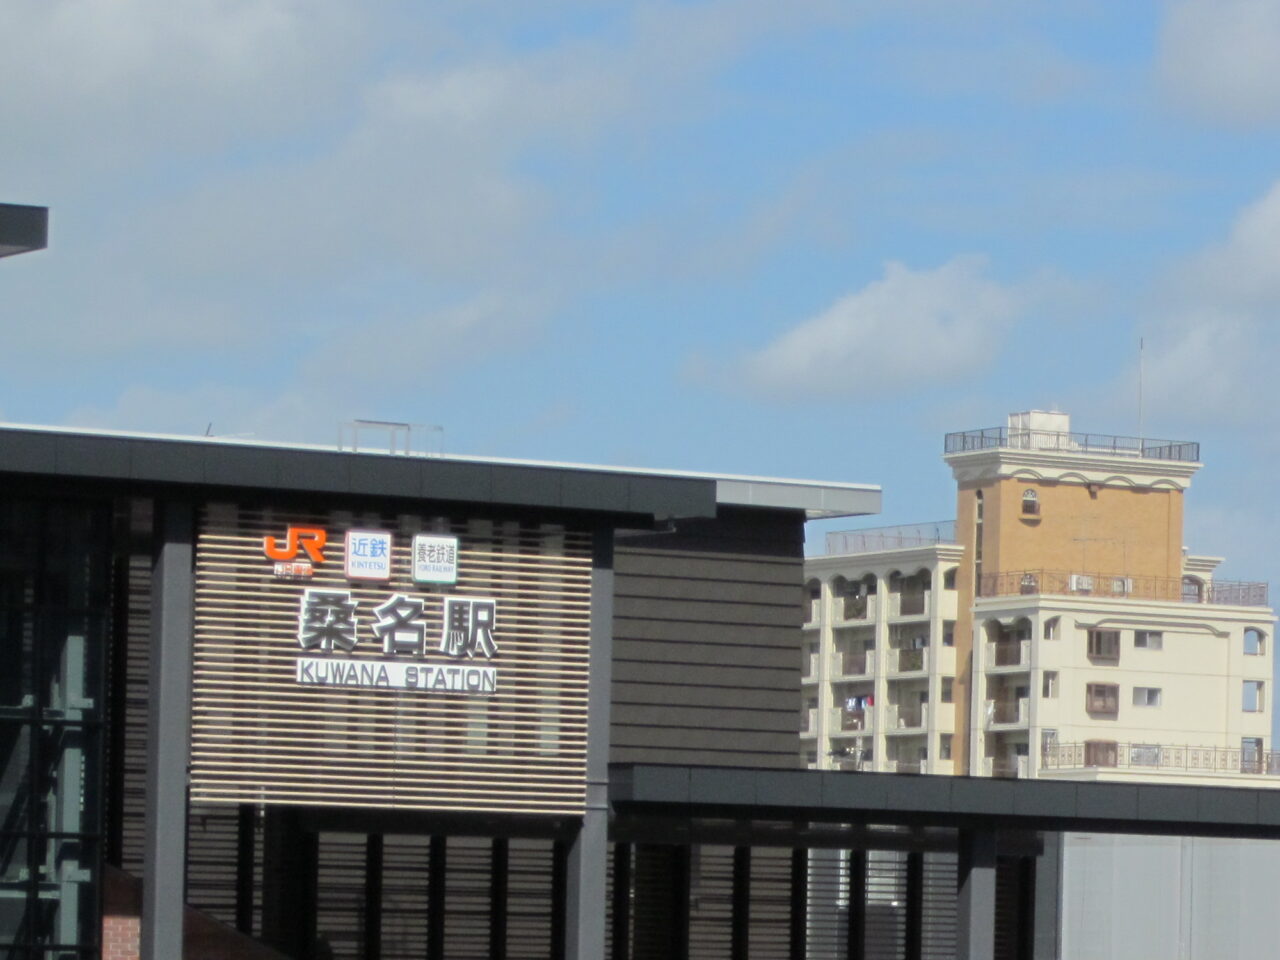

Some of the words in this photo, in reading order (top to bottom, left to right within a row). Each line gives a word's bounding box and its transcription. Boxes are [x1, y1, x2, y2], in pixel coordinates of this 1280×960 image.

[263, 526, 327, 563] JR
[351, 537, 388, 558] 近鉄
[417, 543, 456, 565] 養老鉄道
[351, 560, 387, 571] KINTETSU
[297, 588, 499, 659] 桑名駅
[300, 660, 390, 687] KUWANA
[404, 666, 496, 691] STATION
